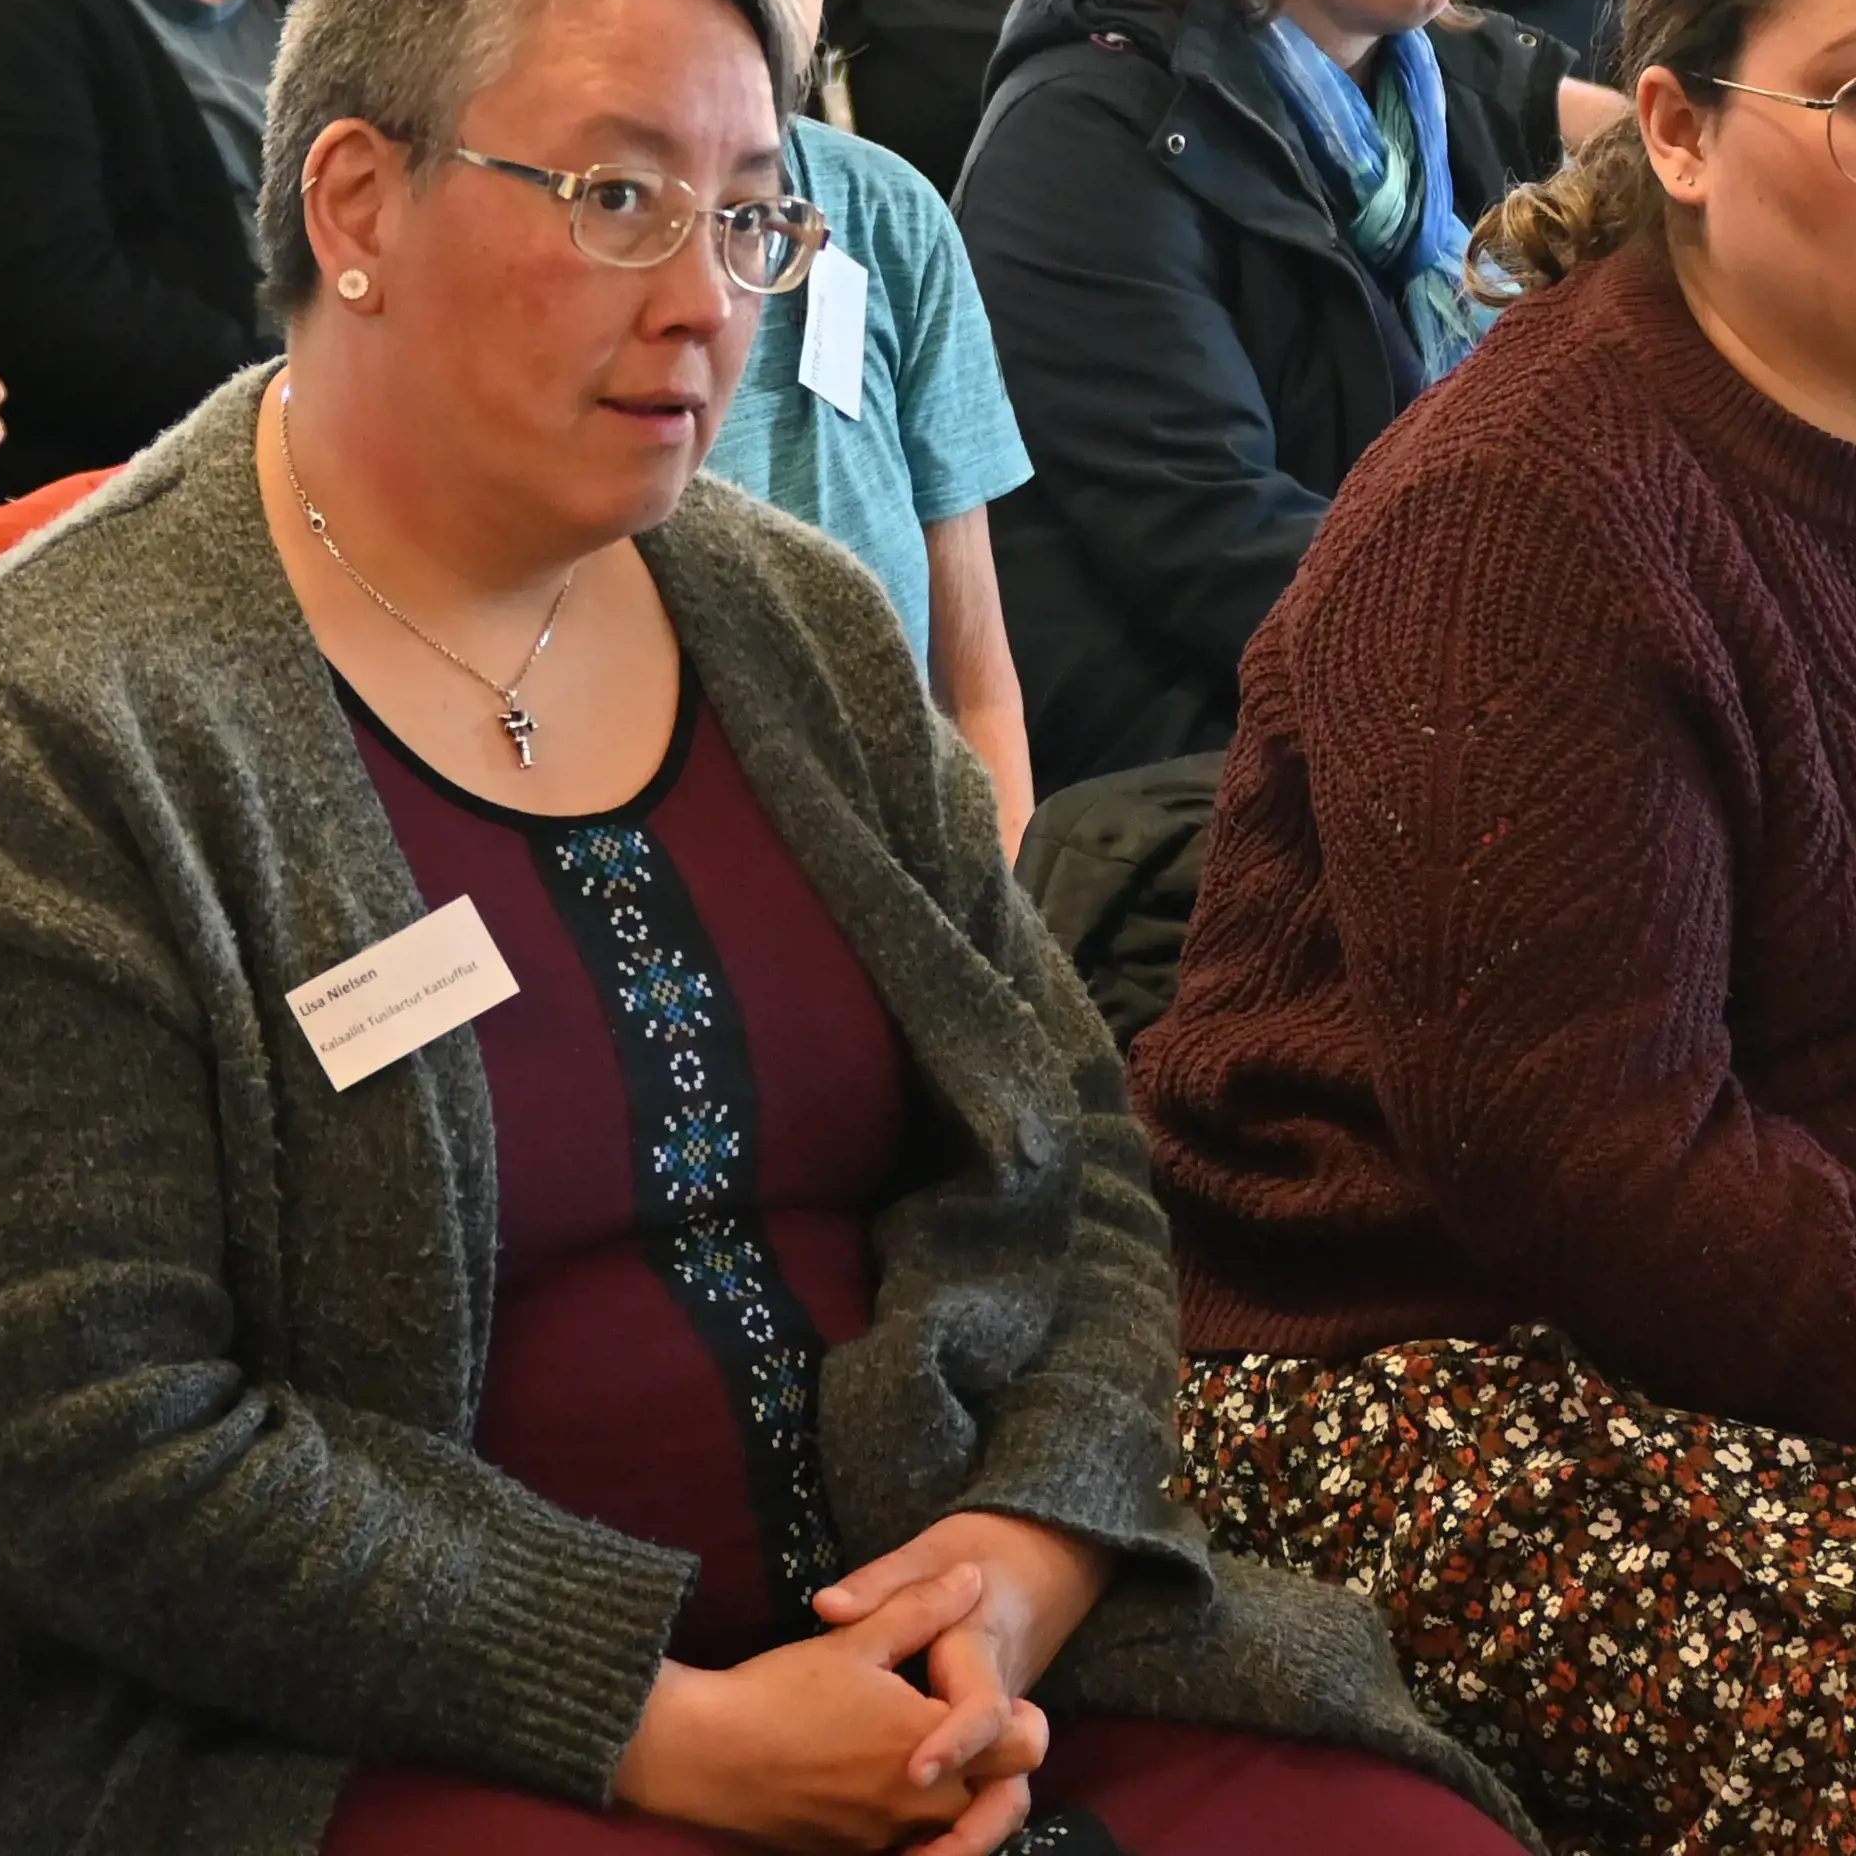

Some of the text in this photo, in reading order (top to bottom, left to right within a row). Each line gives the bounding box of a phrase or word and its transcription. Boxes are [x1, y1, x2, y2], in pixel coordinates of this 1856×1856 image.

[298, 968, 379, 1017] Lisa Nielsen
[319, 960, 480, 1054] Kalaallit Tusilartut Kattuffiat
